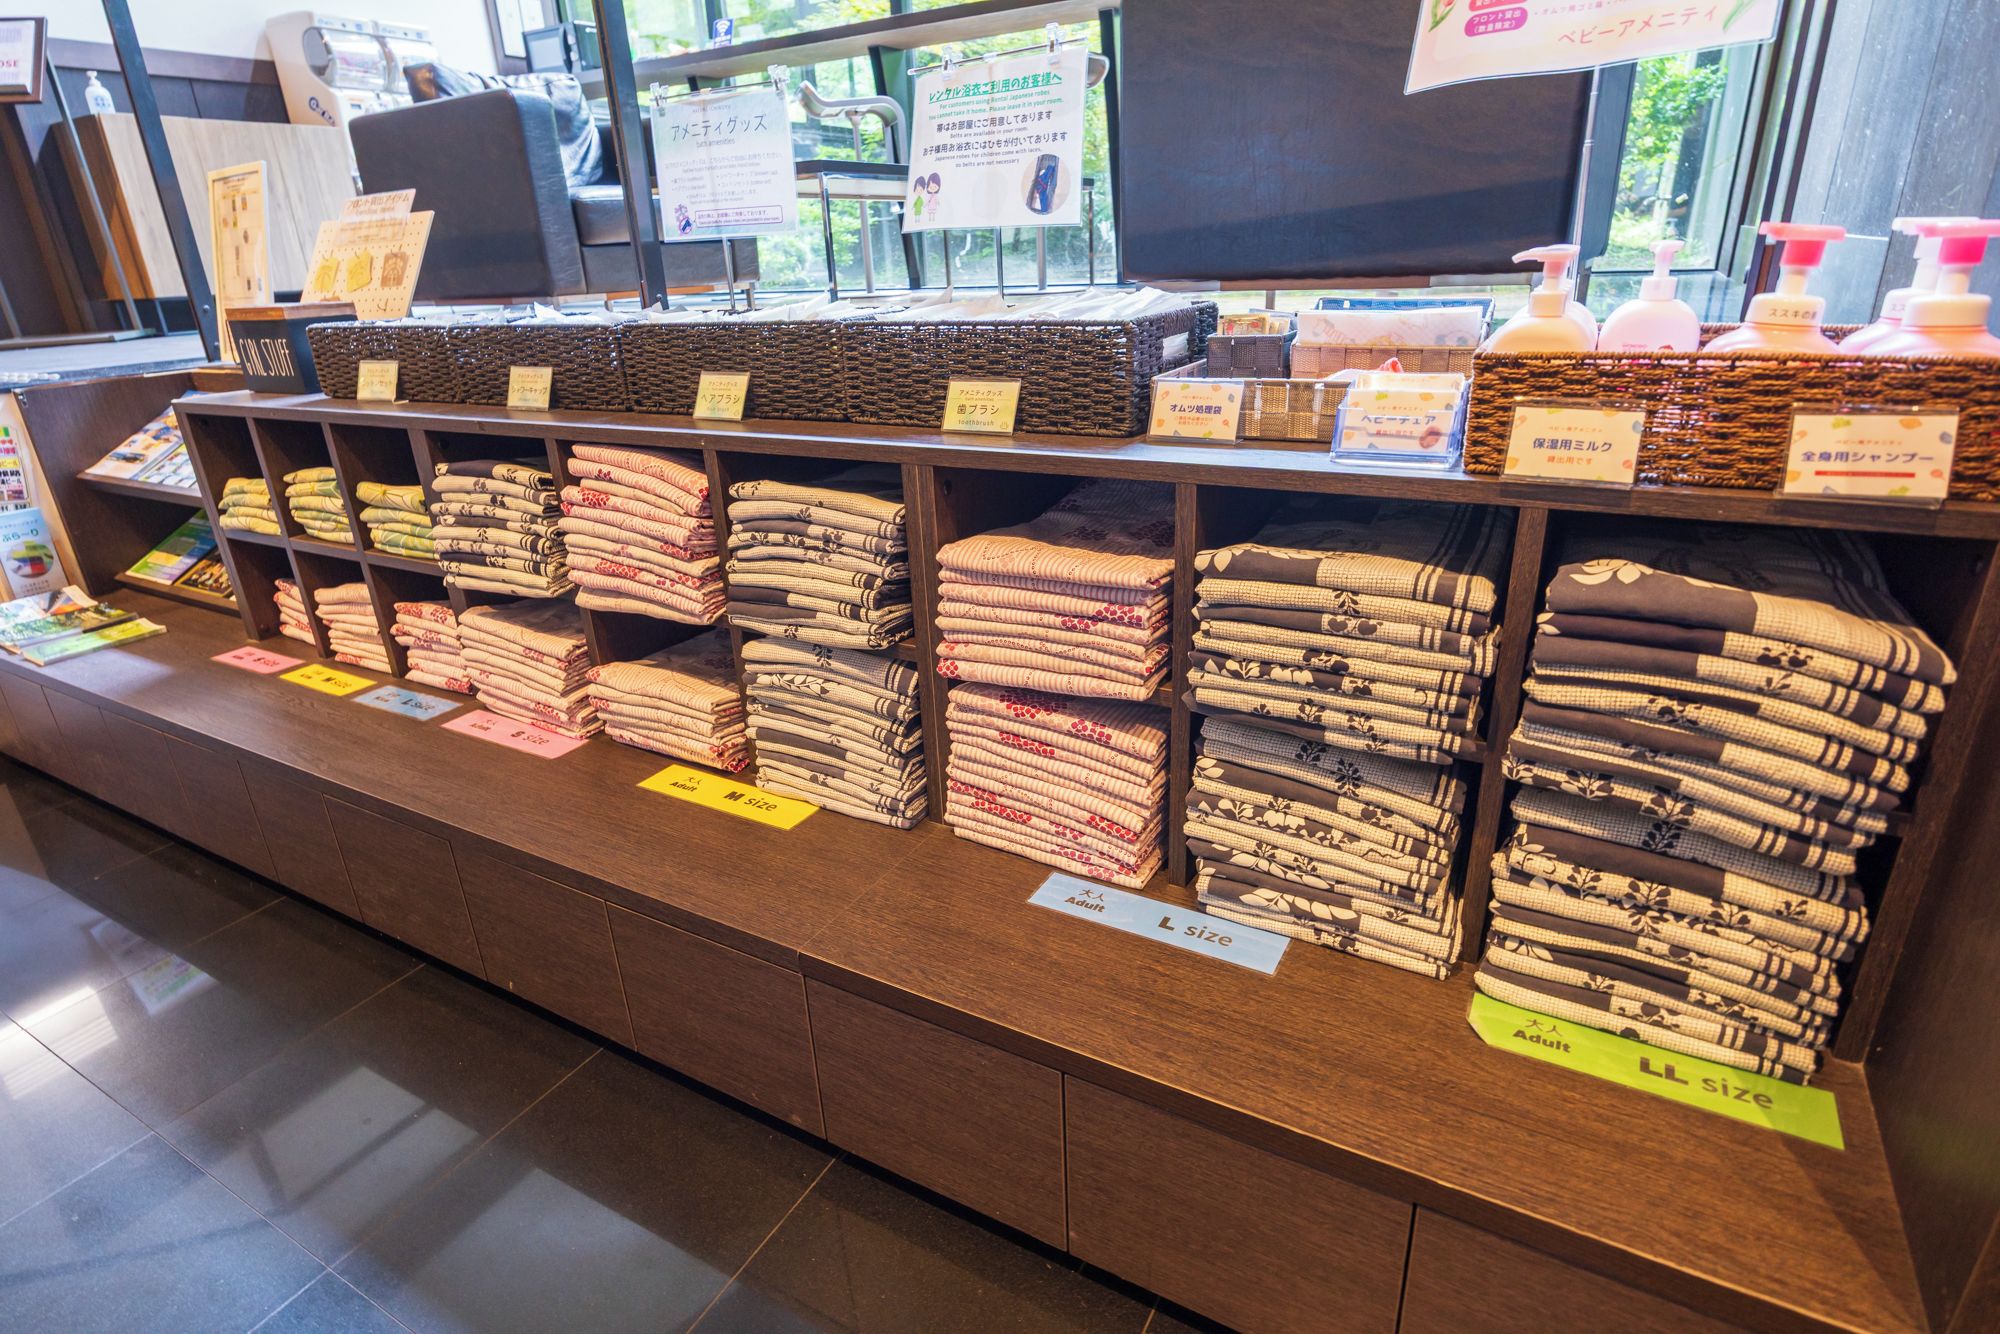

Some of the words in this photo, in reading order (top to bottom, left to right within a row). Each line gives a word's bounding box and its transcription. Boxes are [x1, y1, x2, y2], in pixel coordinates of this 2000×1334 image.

[1472, 9, 1522, 24] フロント貸出
[1558, 6, 1718, 44] ベビーアメニティ
[929, 72, 1062, 102] レンタル浴衣ご利用のお客様へ
[672, 113, 768, 141] アメニティグッズ
[936, 111, 1052, 133] 帯はお部屋にご用意しております
[922, 132, 1067, 157] お子様用お浴衣にはひもが付いております
[240, 339, 268, 376] GIRL
[260, 339, 295, 376] STUFF
[700, 393, 741, 405] ヘアブラシ
[959, 389, 1004, 397] アメニティグッズ
[957, 403, 1000, 415] 歯ブラシ
[1169, 403, 1223, 415] オムツ処理袋
[1532, 437, 1613, 453] 保湿用ミルク
[1800, 450, 1935, 464] 全身用シャンプー
[522, 734, 550, 745] size
[669, 781, 697, 793] Adult
[723, 791, 745, 802] M
[744, 797, 777, 812] size
[1079, 889, 1105, 902] 大人
[1064, 896, 1105, 913] Adult
[1158, 916, 1176, 931] L
[1183, 925, 1233, 947] size
[1525, 1019, 1563, 1037] 大人
[1512, 1029, 1572, 1053] Adult
[1639, 1056, 1689, 1086] LL
[1701, 1077, 1774, 1110] size
